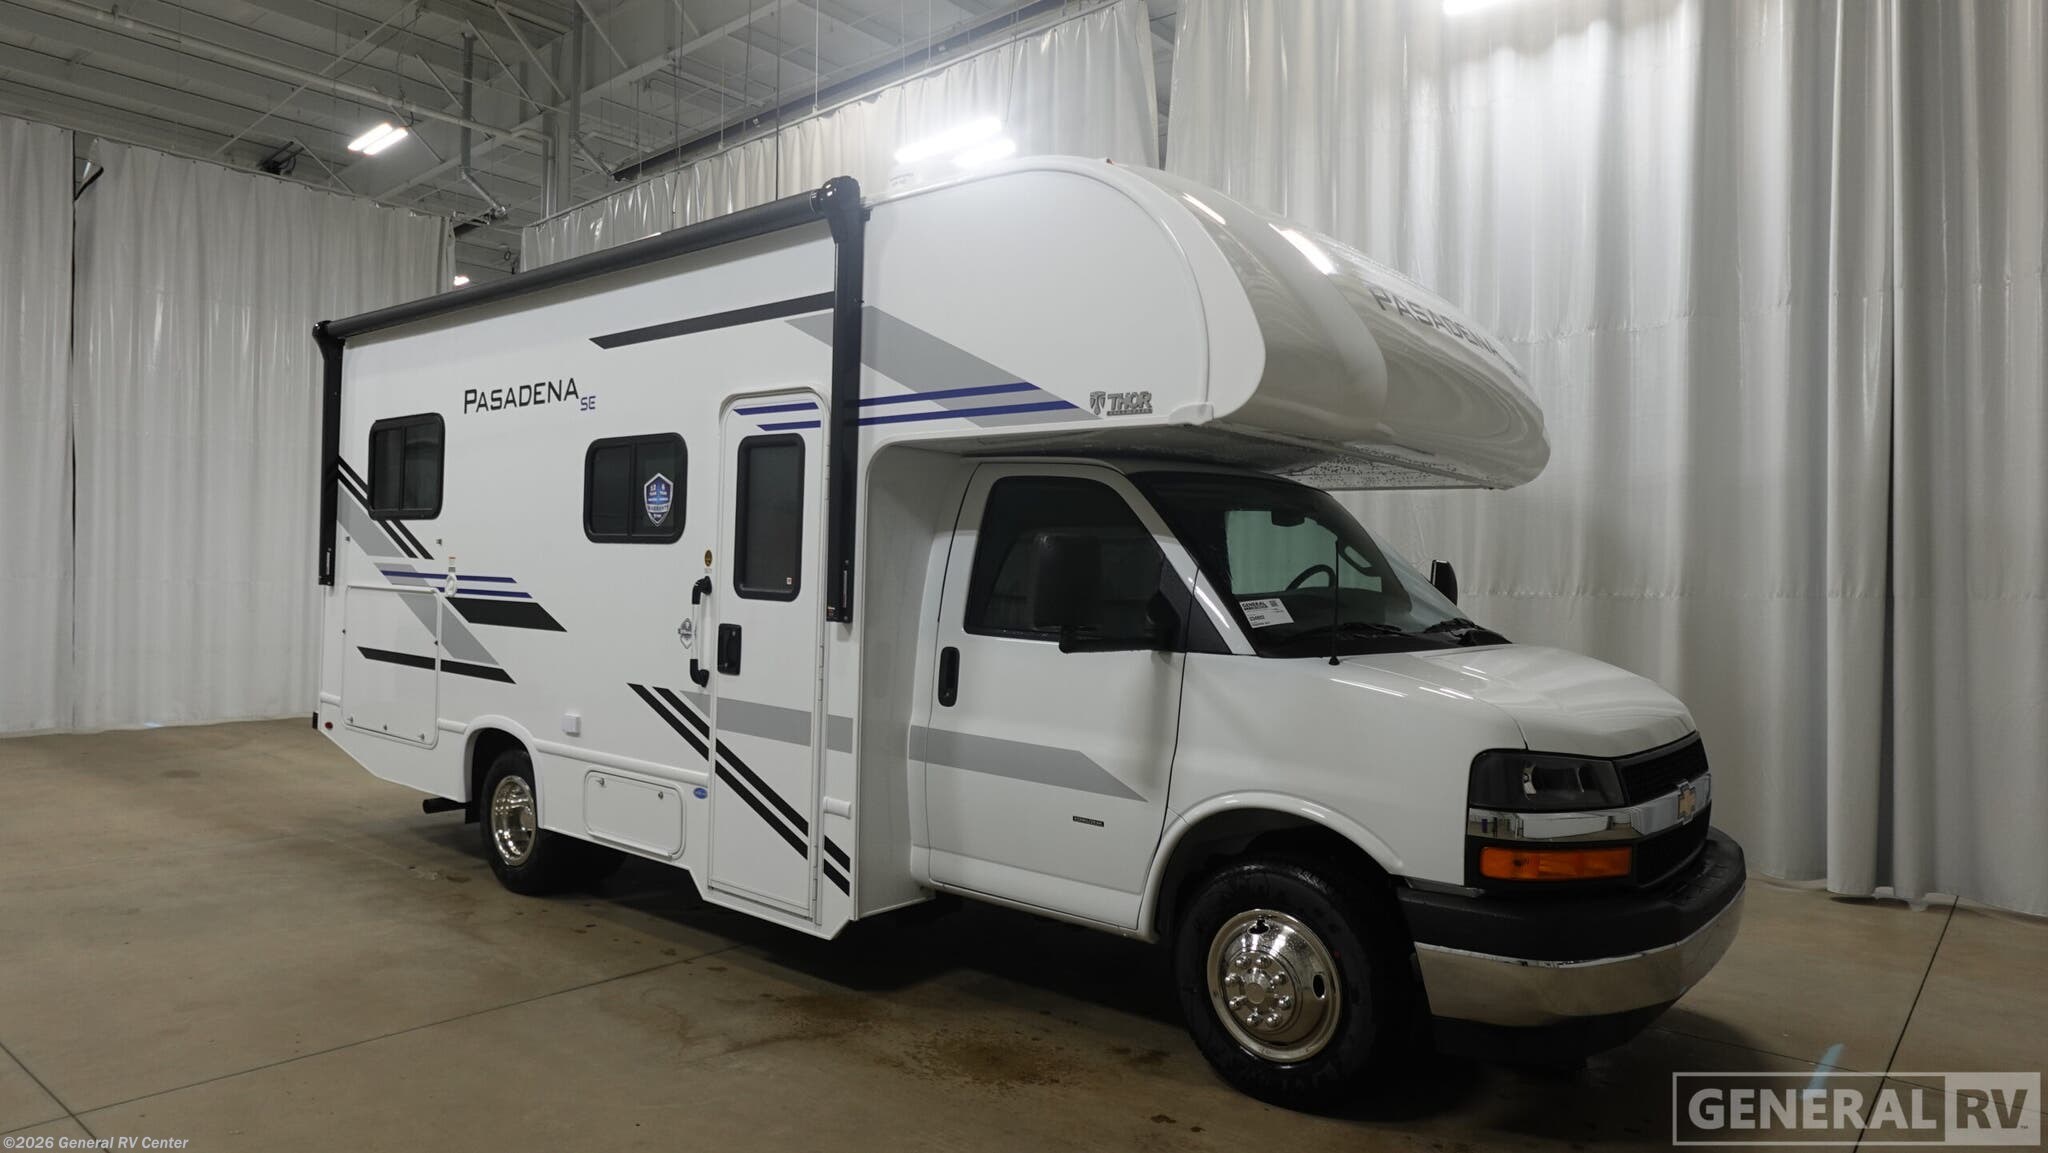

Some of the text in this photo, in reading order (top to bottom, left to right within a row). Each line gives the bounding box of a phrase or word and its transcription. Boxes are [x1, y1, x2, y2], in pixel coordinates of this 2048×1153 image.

[464, 377, 596, 414] PASADENA SE
[1107, 391, 1152, 411] THOR
